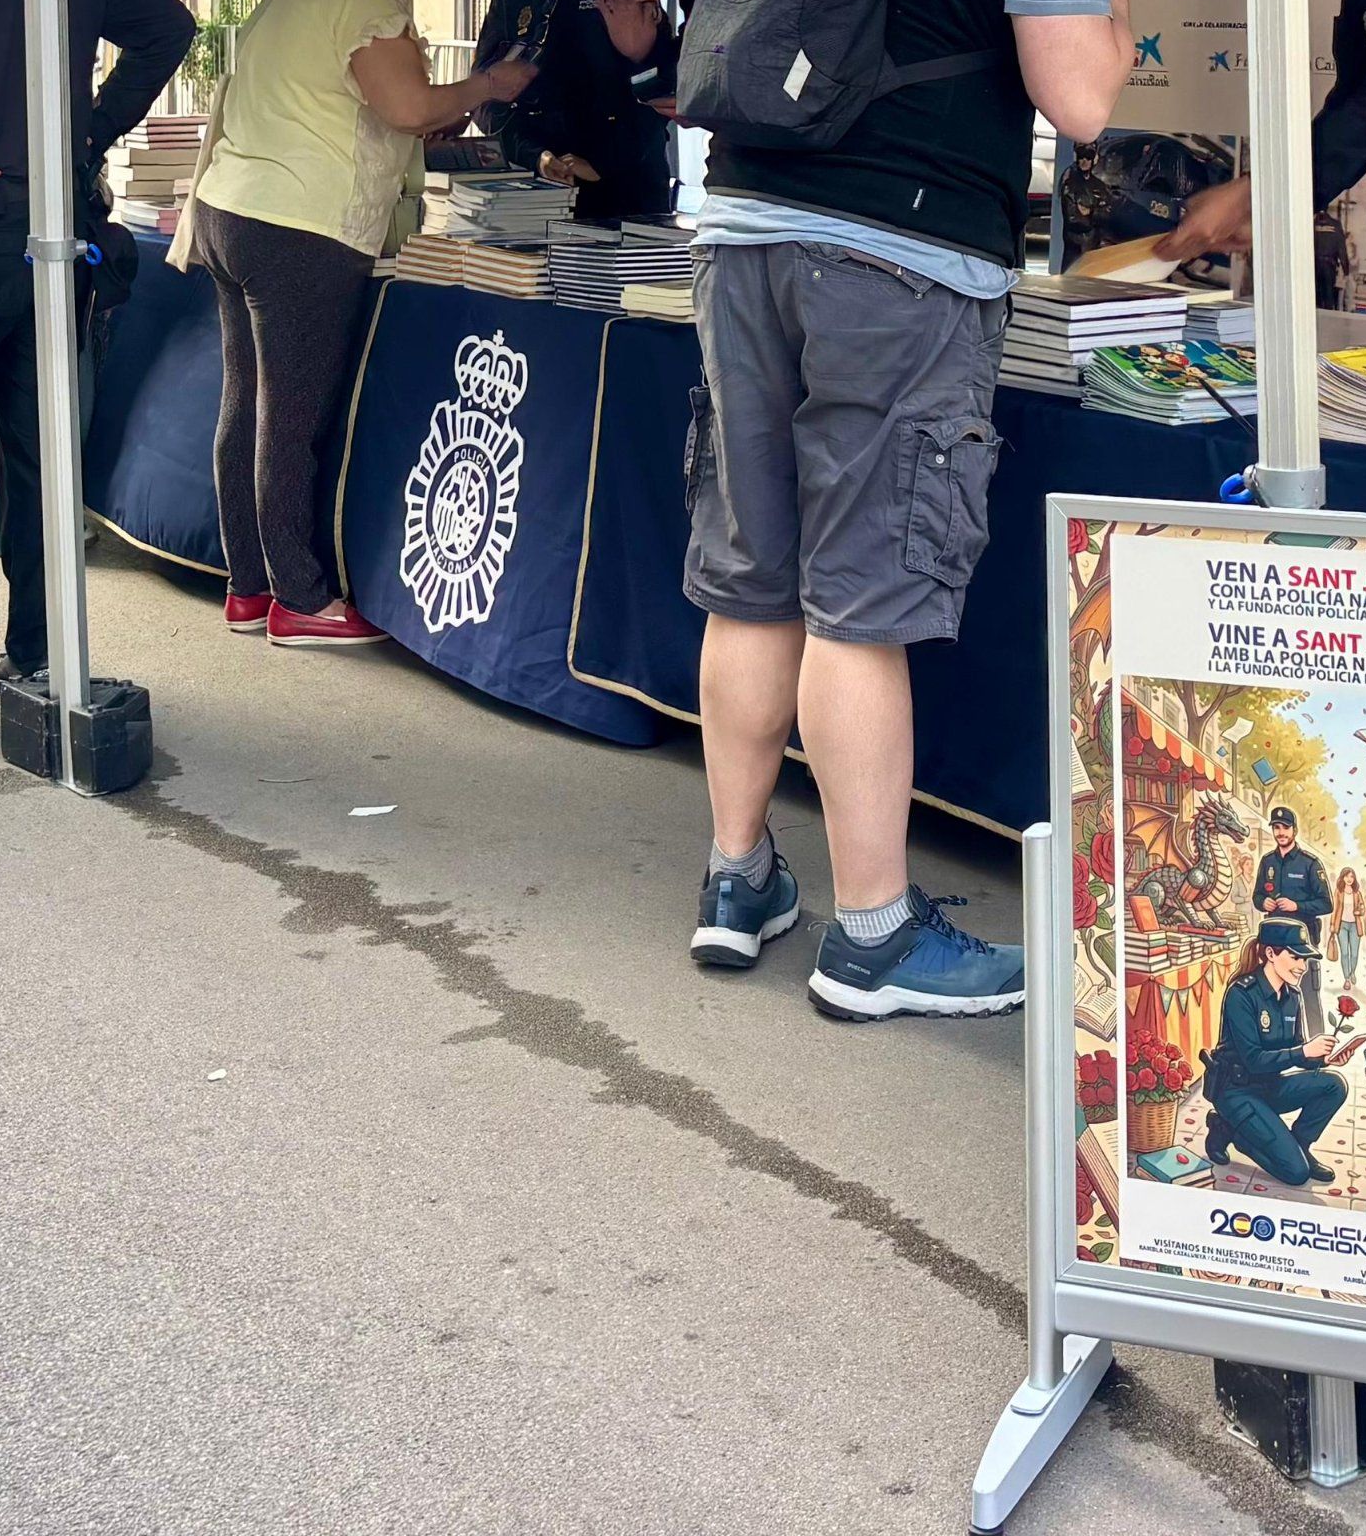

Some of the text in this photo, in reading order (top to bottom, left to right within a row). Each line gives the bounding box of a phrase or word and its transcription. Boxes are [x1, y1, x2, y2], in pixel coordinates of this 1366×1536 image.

[429, 533, 477, 574] NACIONAL
[1206, 560, 1256, 584] VEN
[1264, 564, 1281, 585] A
[1288, 566, 1356, 590] SANT
[1208, 598, 1216, 610] Y
[1219, 599, 1234, 611] LA
[1238, 600, 1314, 617] FUNDACIÓN
[1210, 583, 1246, 599] CON
[1251, 586, 1272, 601] LA
[1277, 587, 1344, 606] POLICÍA
[1208, 622, 1265, 647] VINE
[1272, 628, 1289, 648] A
[1295, 630, 1362, 654] SANT
[1211, 646, 1249, 661] AMB
[1254, 649, 1274, 663] LA
[1280, 651, 1347, 670] POLICIA
[1215, 660, 1231, 673] LA
[1235, 663, 1304, 679] FUNDACIÓ
[1308, 669, 1360, 683] POLICIA
[1210, 1209, 1276, 1242] 200
[1154, 1238, 1295, 1267] VISÍTANOS EN NUESTRO PUESTO
